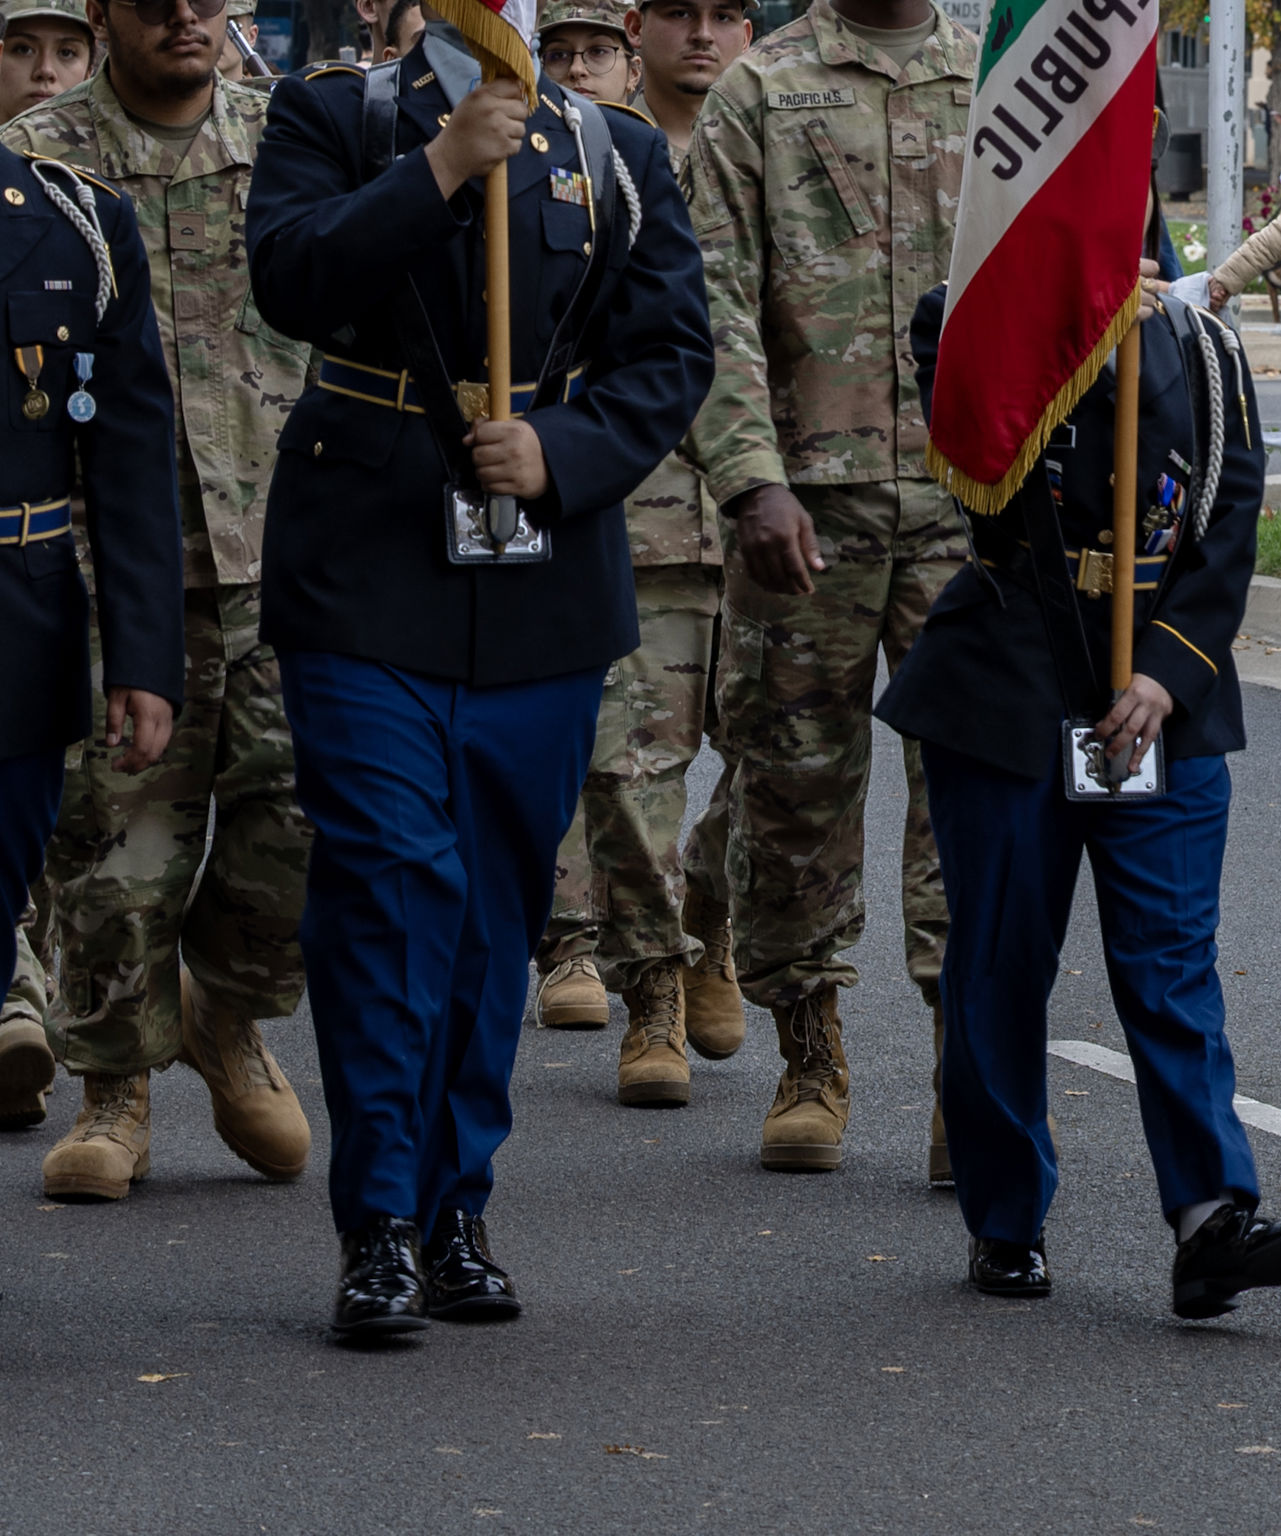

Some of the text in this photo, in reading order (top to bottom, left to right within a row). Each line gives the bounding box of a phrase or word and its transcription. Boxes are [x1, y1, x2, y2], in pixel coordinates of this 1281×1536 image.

[942, 2, 981, 18] ENDS
[778, 91, 845, 106] PACIFIC H.S.
